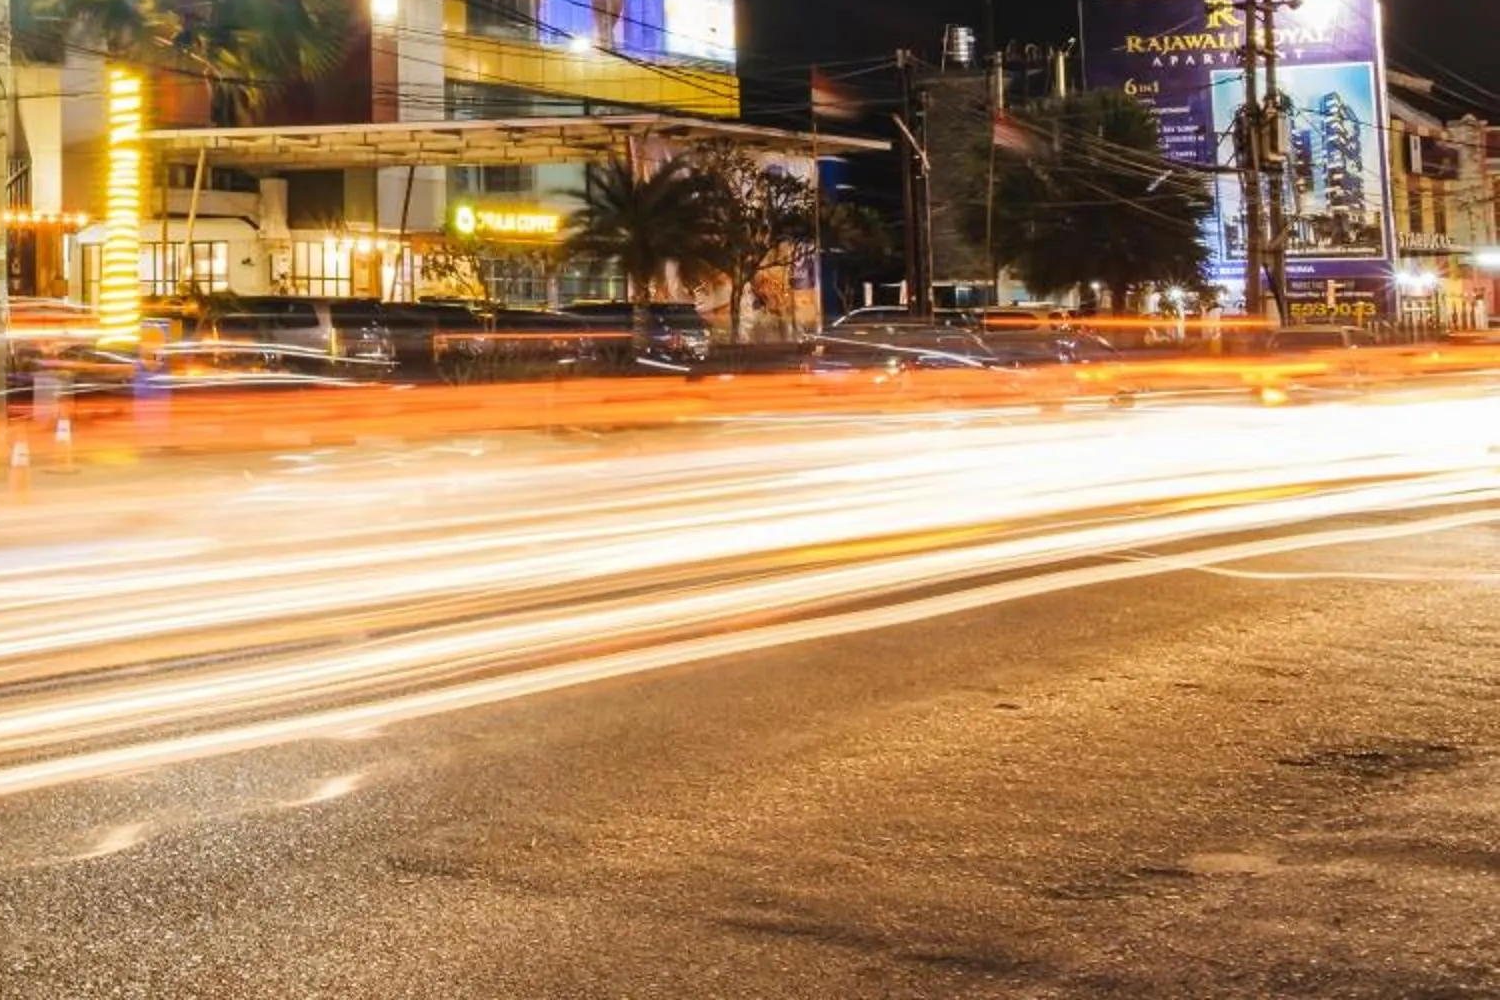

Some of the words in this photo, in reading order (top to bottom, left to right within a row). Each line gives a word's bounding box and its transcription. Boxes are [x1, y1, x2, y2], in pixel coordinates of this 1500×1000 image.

[1125, 31, 1241, 55] RAJAWALI
[1152, 47, 1306, 67] APARTNT
[1124, 78, 1138, 96] 6
